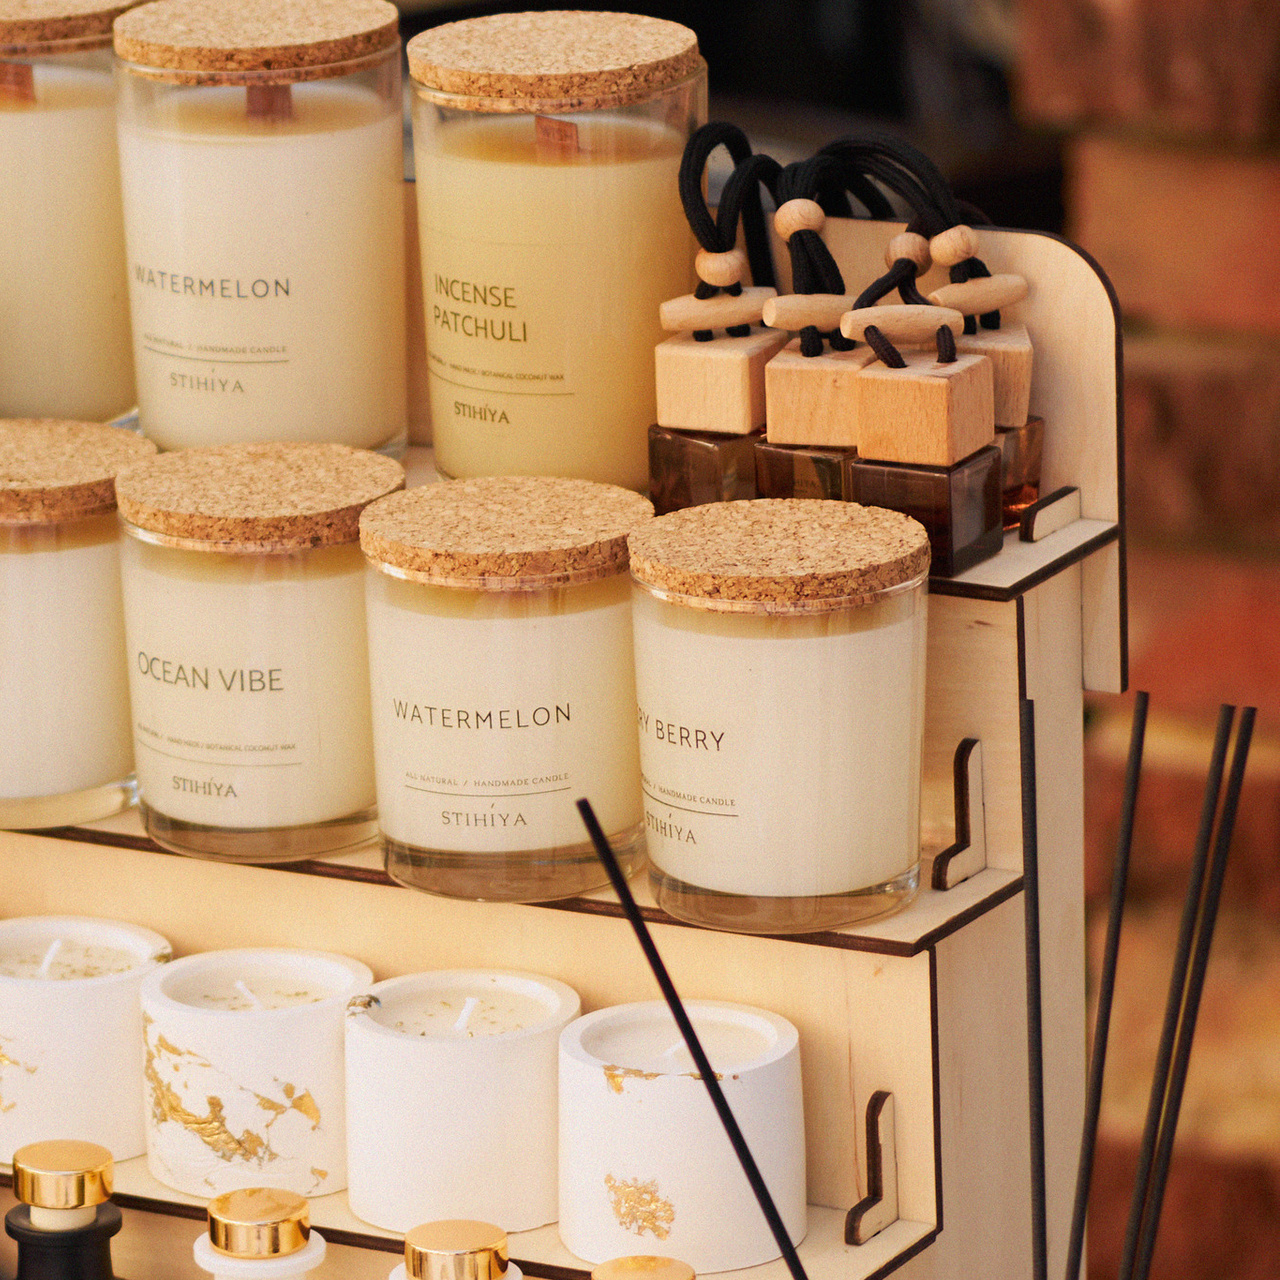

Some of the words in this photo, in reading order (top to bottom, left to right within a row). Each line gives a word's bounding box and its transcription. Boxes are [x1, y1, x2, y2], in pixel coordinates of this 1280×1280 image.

[135, 264, 290, 299] WATERMELON
[435, 273, 517, 309] INCENSE
[433, 304, 527, 343] PATCHULI
[138, 651, 209, 691] OCEAN
[218, 668, 285, 693] VIBE
[393, 698, 571, 730] WATERMELON
[655, 719, 726, 752] BERRY
[405, 772, 418, 781] ALL
[420, 774, 458, 786] NATURAL
[474, 778, 529, 787] HANDMADE
[532, 772, 569, 784] CANDLE
[659, 785, 697, 803] HANDMADE
[699, 796, 736, 807] CANDLE
